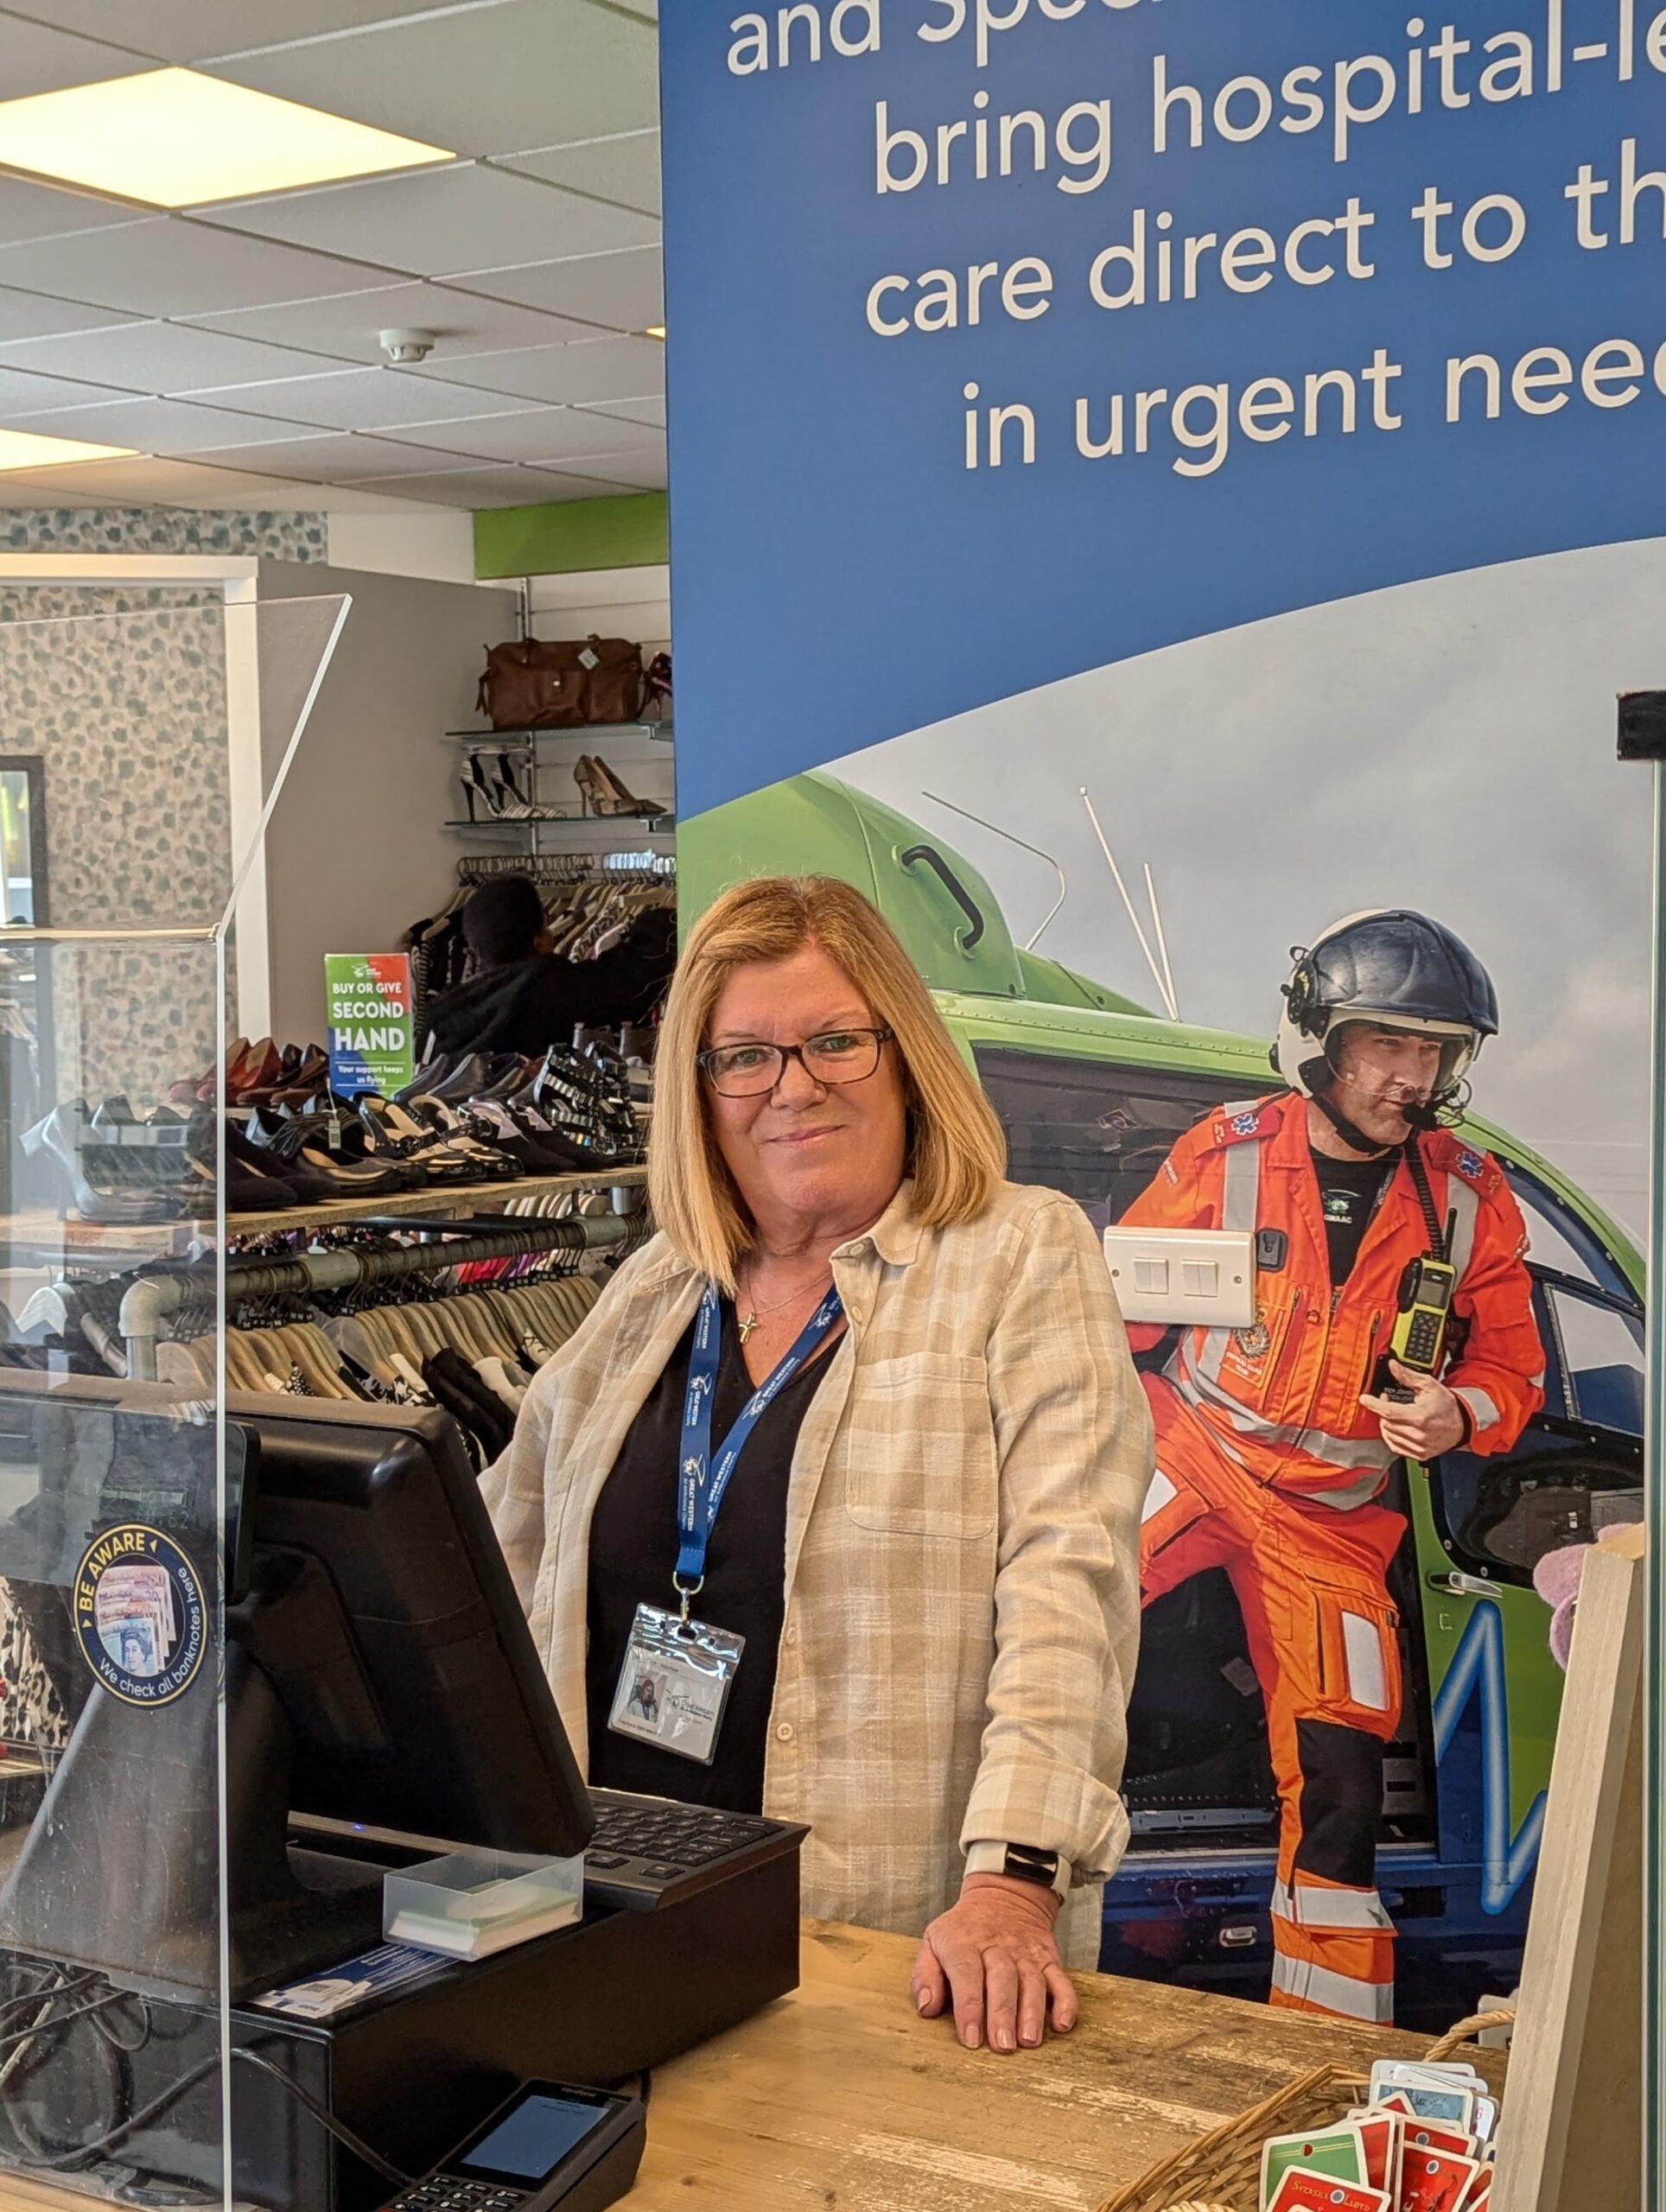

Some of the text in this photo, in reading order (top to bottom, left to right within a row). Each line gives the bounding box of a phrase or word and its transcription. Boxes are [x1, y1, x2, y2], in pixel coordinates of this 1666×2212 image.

[728, 0, 881, 75] and
[875, 91, 1111, 194] bring
[866, 138, 1666, 336] care direct to th
[963, 339, 1666, 477] in urgent nee
[332, 982, 402, 995] BUY OR GIVE
[333, 1001, 404, 1020] SECOND
[334, 1027, 405, 1052] HAND
[338, 1065, 404, 1076] Your support keeps
[366, 1075, 386, 1085] flying
[709, 1452, 733, 1502] GREAT WESTERN
[79, 1532, 146, 1612] BE AWARE
[99, 1567, 200, 1697] We check all banknotes here
